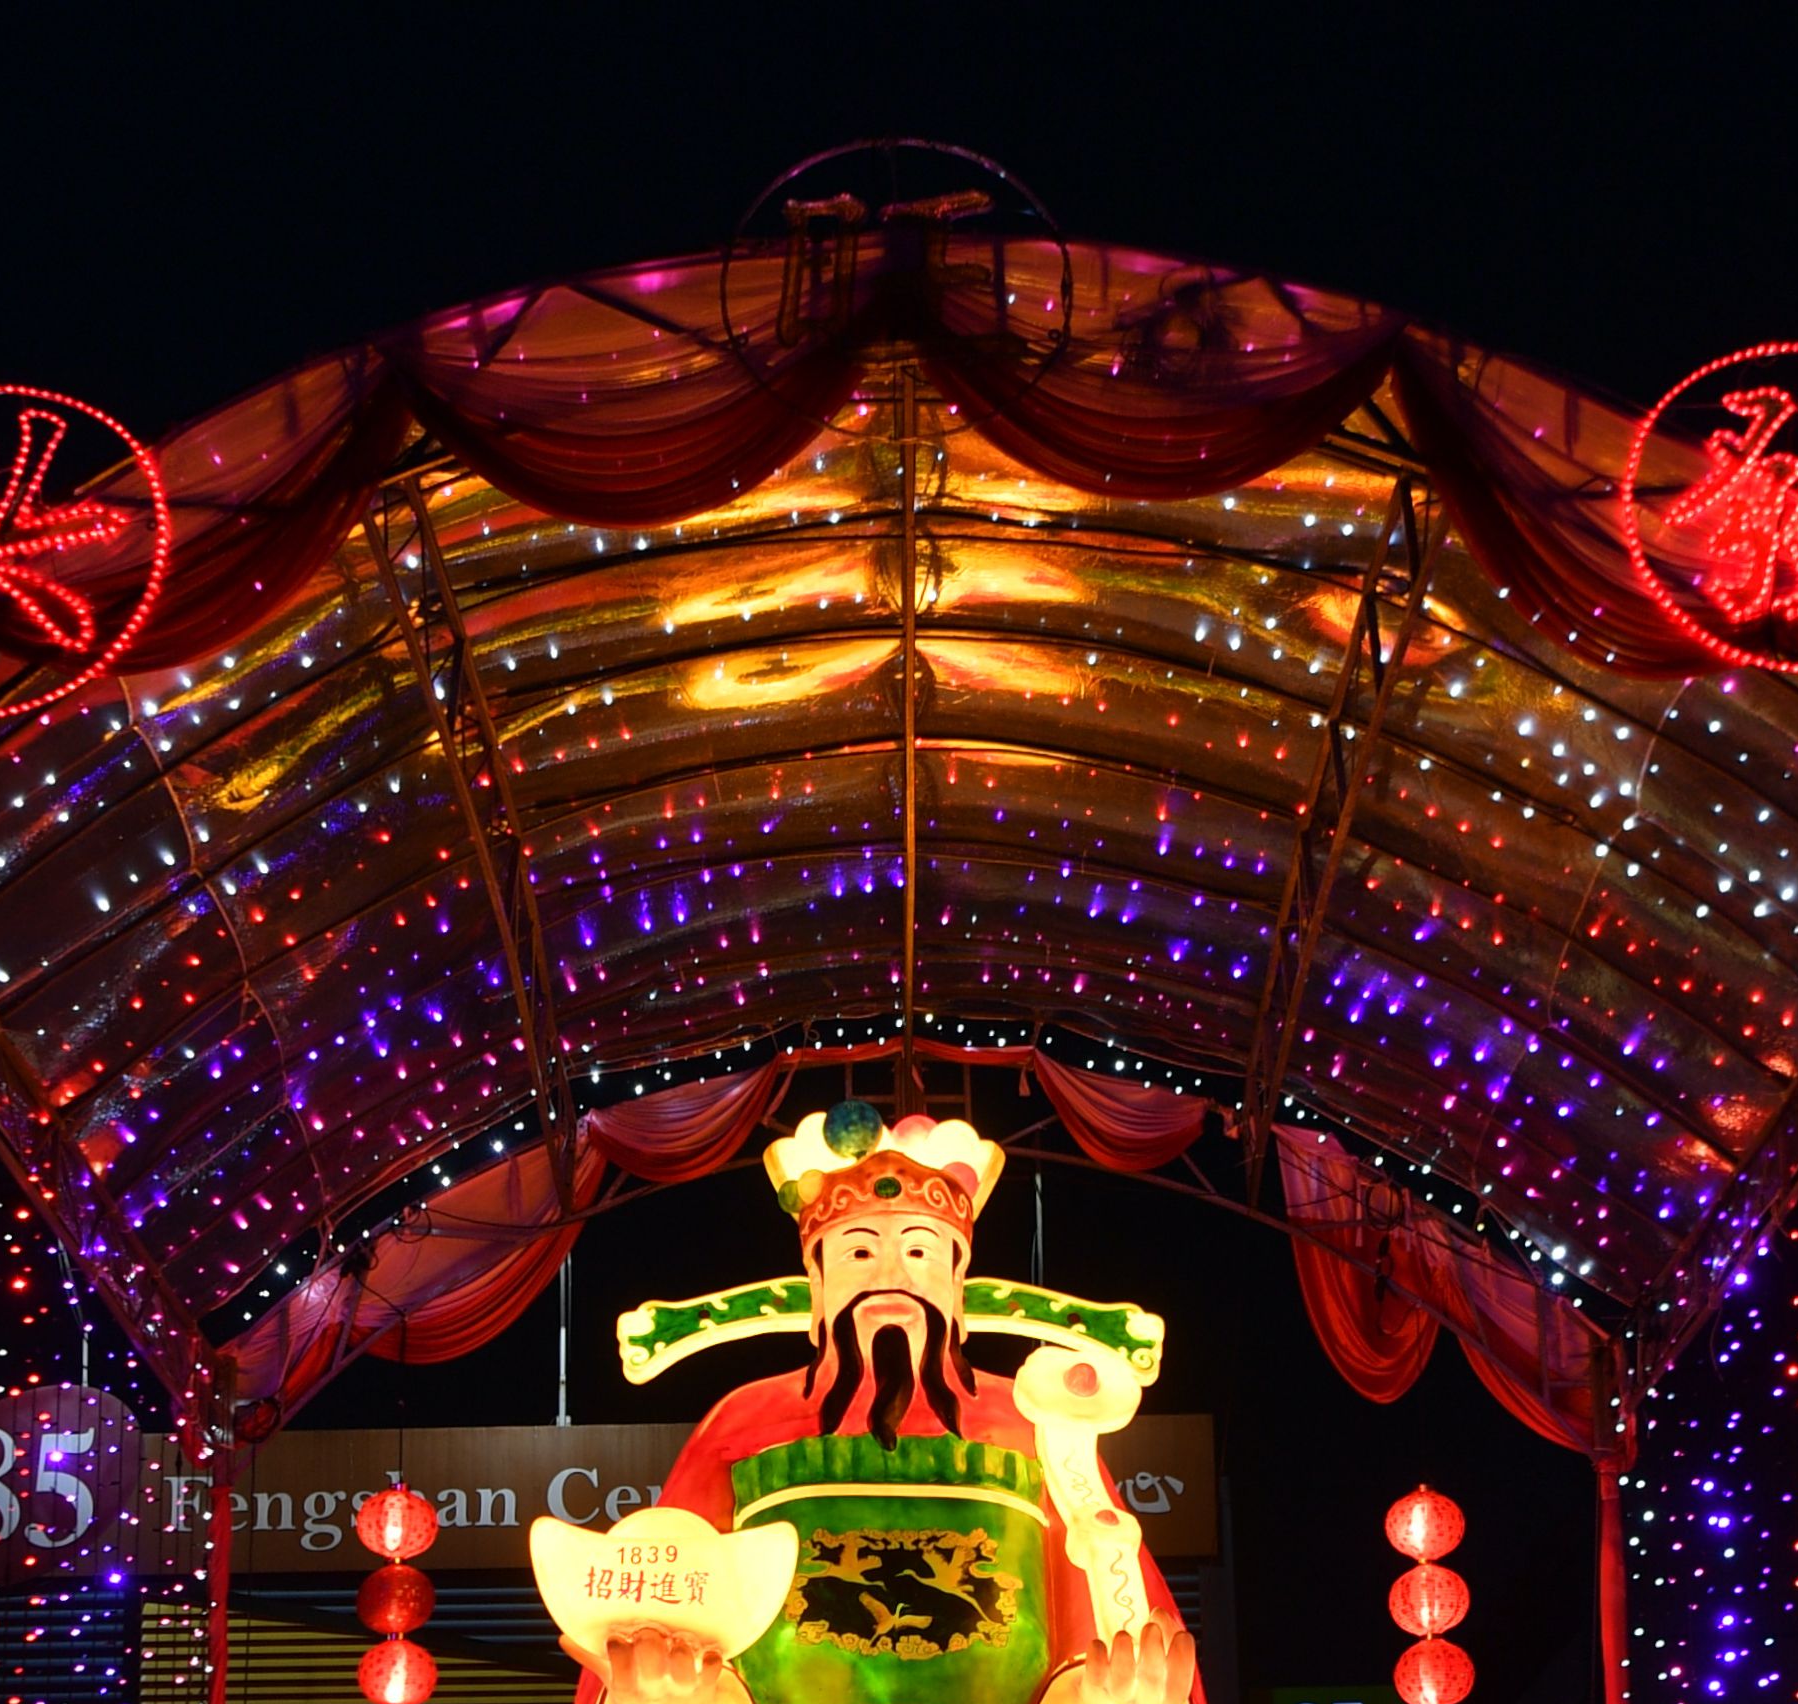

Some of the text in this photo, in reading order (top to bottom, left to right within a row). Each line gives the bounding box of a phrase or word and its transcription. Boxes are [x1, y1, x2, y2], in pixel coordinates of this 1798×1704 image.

[164, 1470, 520, 1552] Fengan
[618, 1545, 678, 1564] 1839
[584, 1566, 709, 1605] 招財進寶
